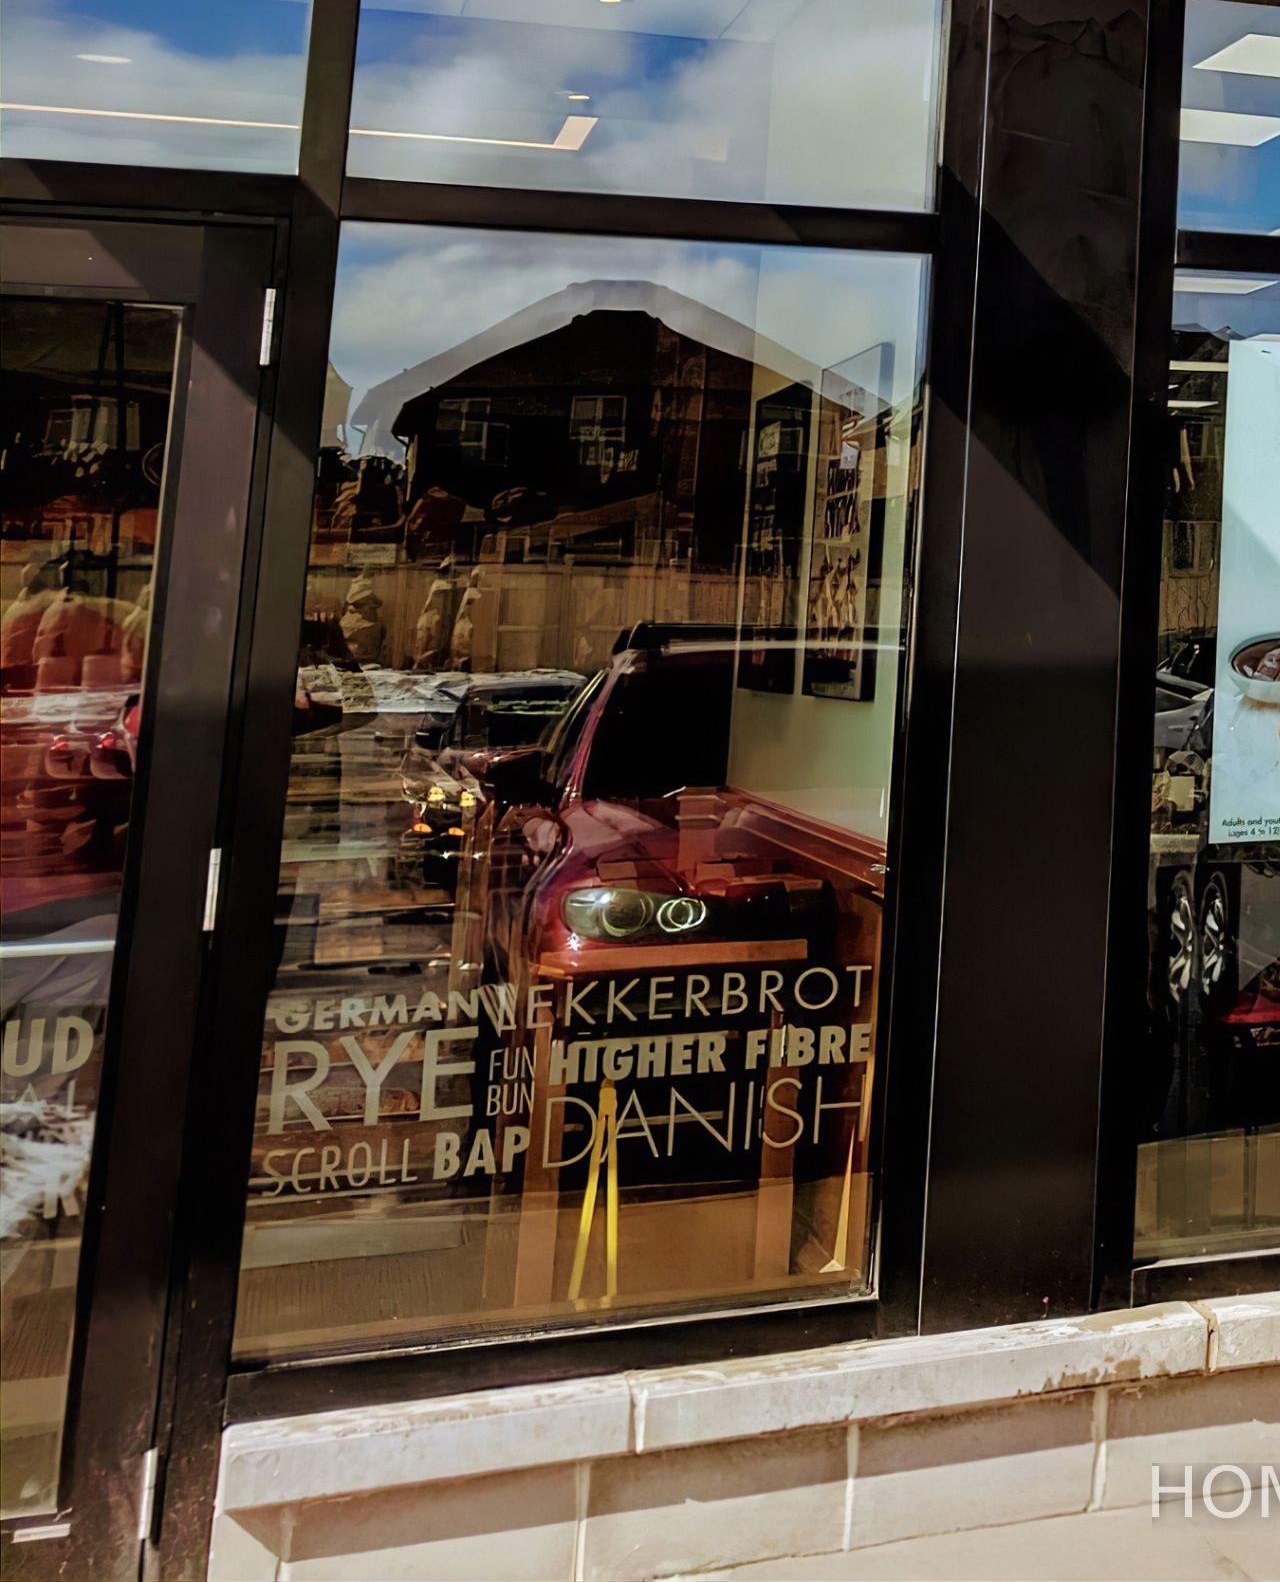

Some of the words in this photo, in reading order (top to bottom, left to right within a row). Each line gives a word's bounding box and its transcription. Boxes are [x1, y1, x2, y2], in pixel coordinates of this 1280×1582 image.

[1247, 816, 1262, 826] and
[274, 989, 481, 1034] GERMAN
[267, 1025, 479, 1135] RYE
[488, 1046, 536, 1082] FUN
[550, 1030, 726, 1086] HIGHER
[745, 1024, 871, 1069] FIBRE
[486, 1082, 535, 1117] BUN
[542, 1074, 866, 1168] DANISH
[261, 1138, 418, 1197] SCROLL
[433, 1125, 531, 1180] BAP
